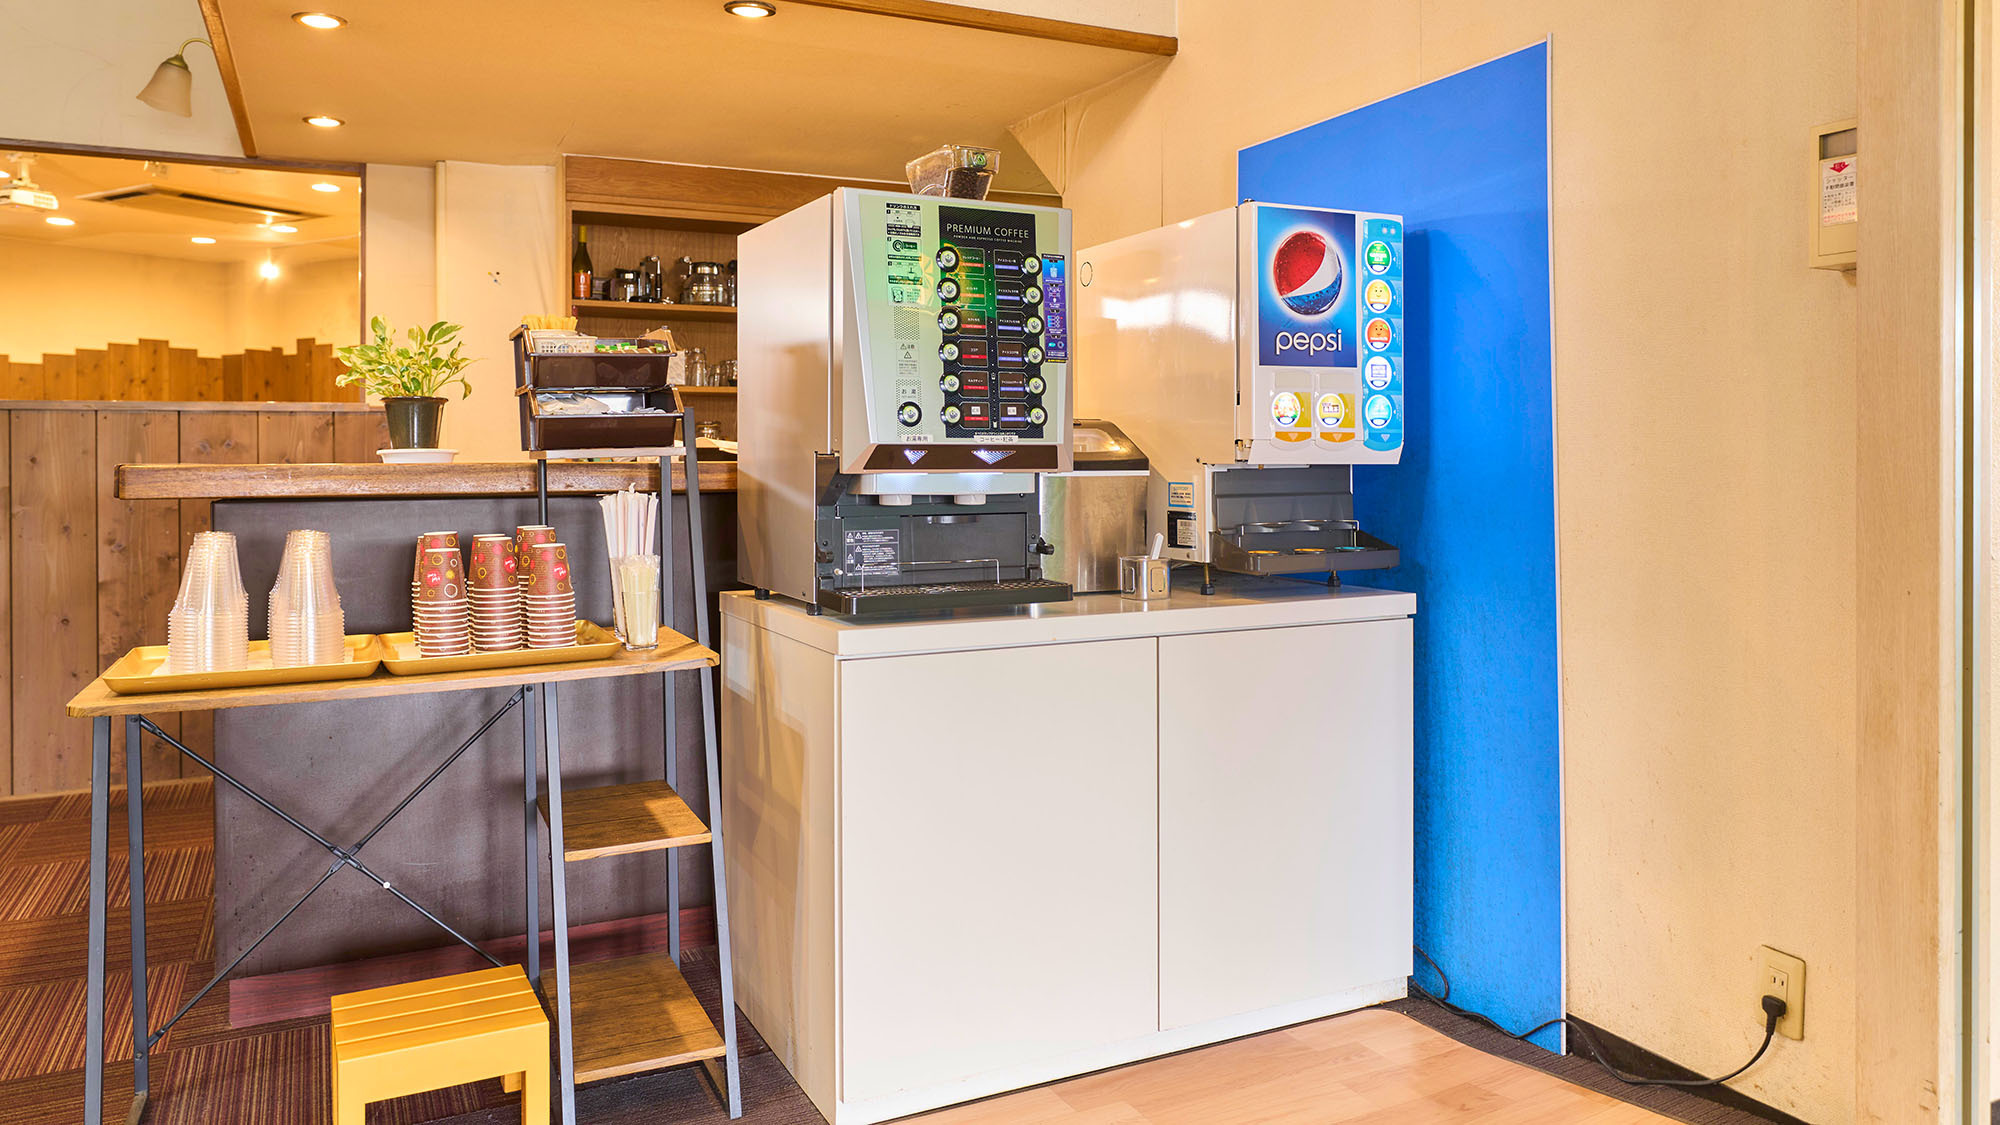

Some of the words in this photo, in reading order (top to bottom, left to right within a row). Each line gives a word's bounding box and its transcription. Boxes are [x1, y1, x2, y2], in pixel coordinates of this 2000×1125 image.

[946, 223, 992, 235] PREMIUM
[994, 227, 1030, 239] COFFEE
[1275, 329, 1342, 356] pepsi
